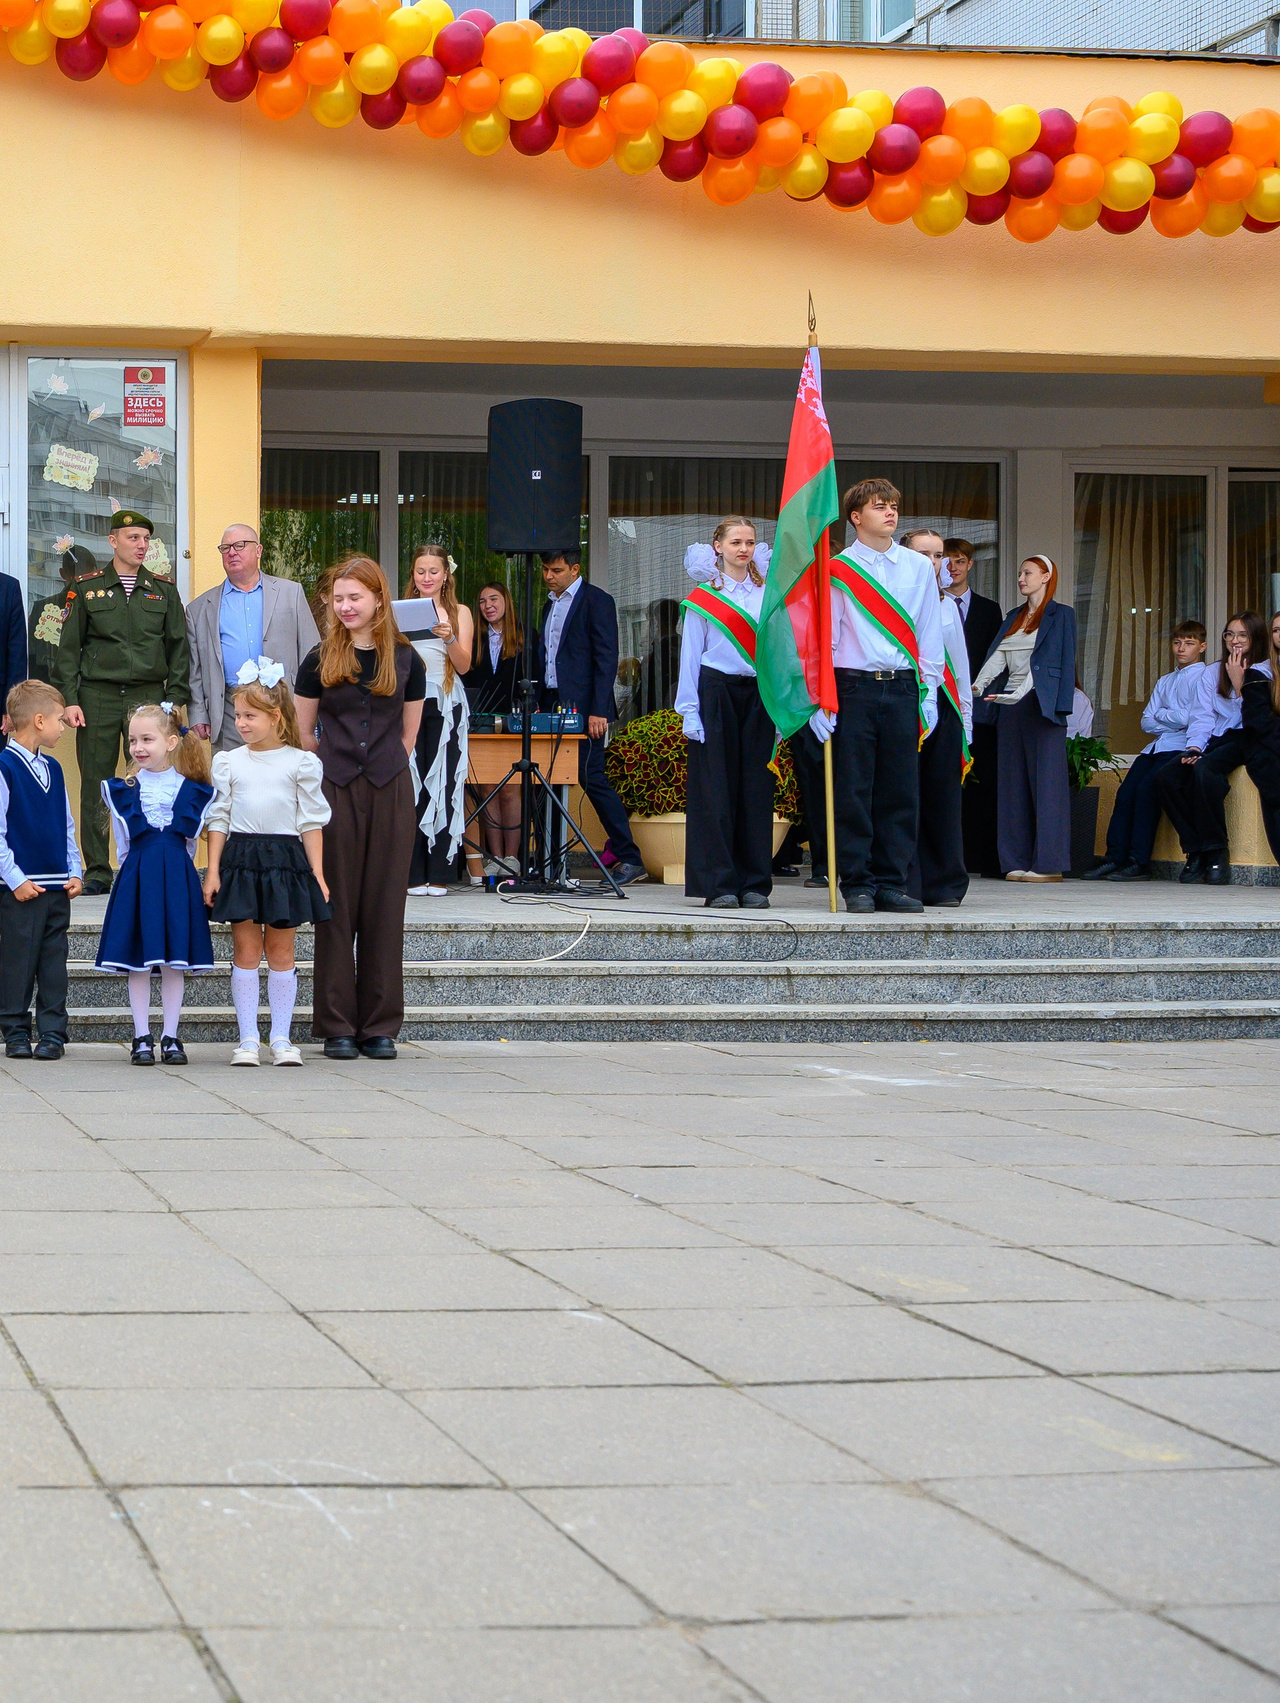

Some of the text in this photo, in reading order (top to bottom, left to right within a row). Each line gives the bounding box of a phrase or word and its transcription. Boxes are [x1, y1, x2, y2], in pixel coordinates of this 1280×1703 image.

[127, 398, 163, 408] ЗДЕСЬ
[56, 447, 87, 464] Вперёд
[55, 458, 91, 474] знаниям!
